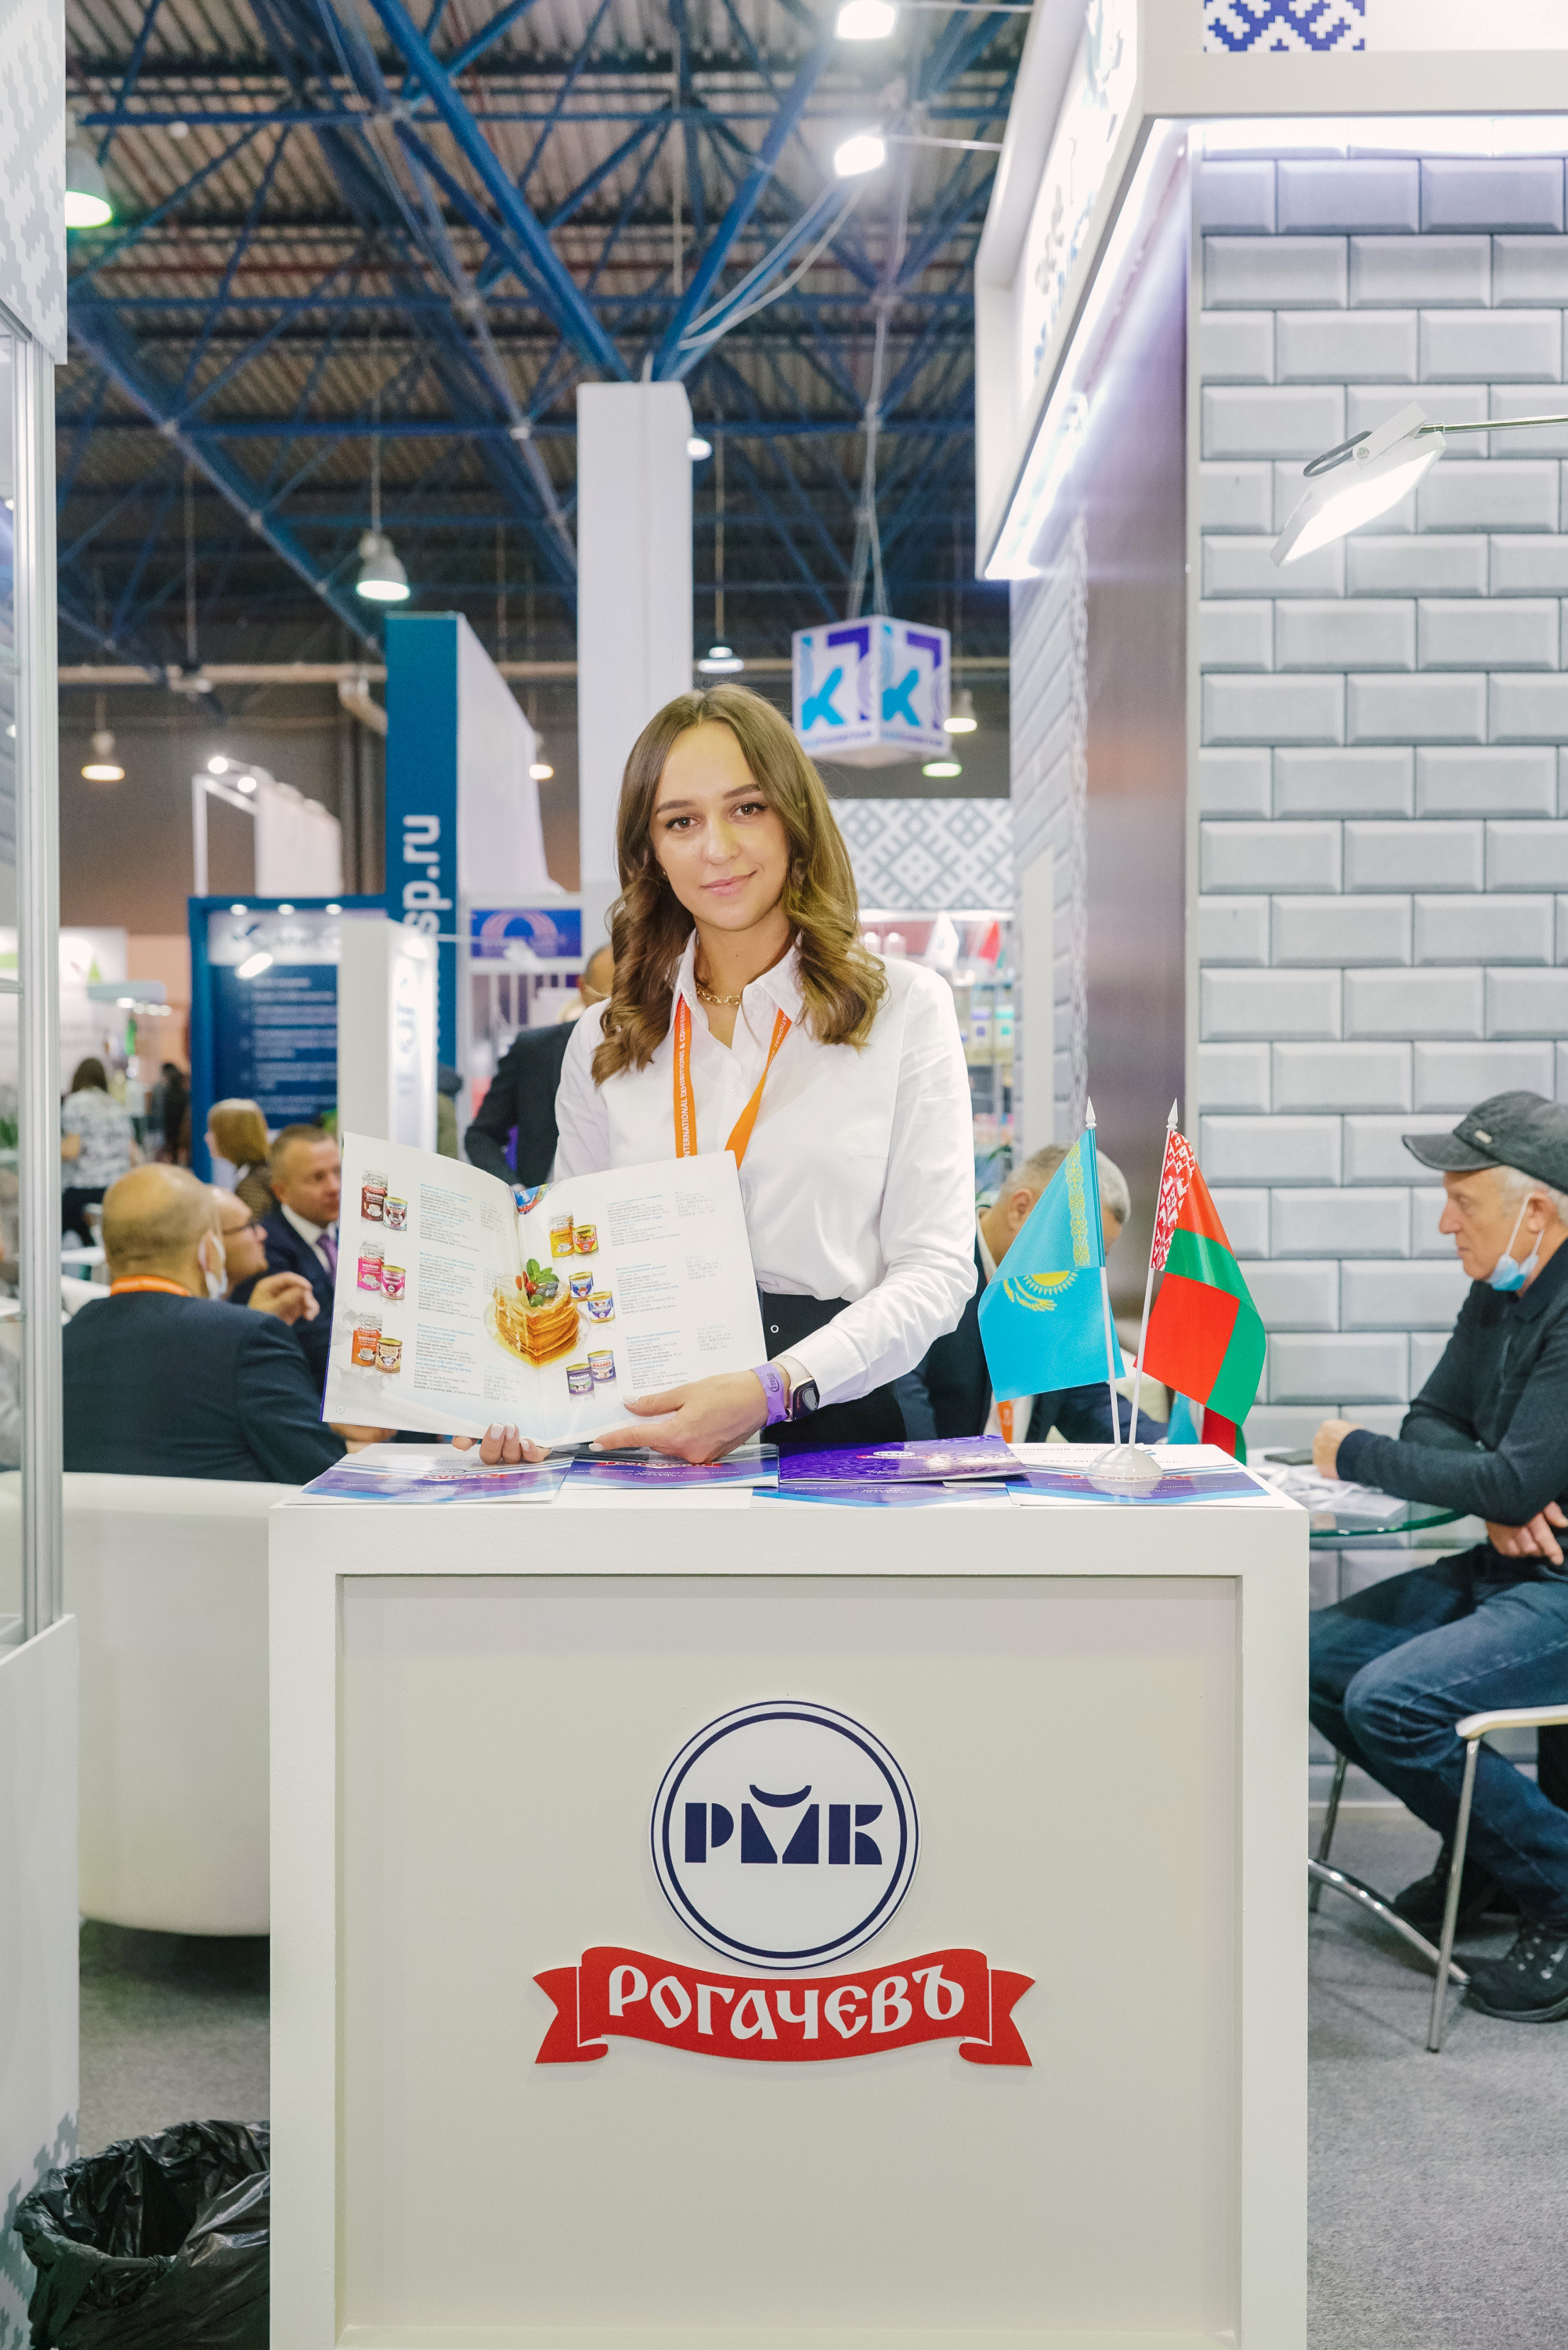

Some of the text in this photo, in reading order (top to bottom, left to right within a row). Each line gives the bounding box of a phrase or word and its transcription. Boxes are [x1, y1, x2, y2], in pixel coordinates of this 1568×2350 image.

[403, 815, 453, 935] sp.ru
[679, 1042, 687, 1050] &
[775, 1014, 788, 1048] ATIONAL
[679, 1051, 688, 1097] EXHIBITIONS
[681, 1098, 691, 1157] NTERNATIONAL
[609, 1964, 965, 2040] РОГАЧЕВЪ
